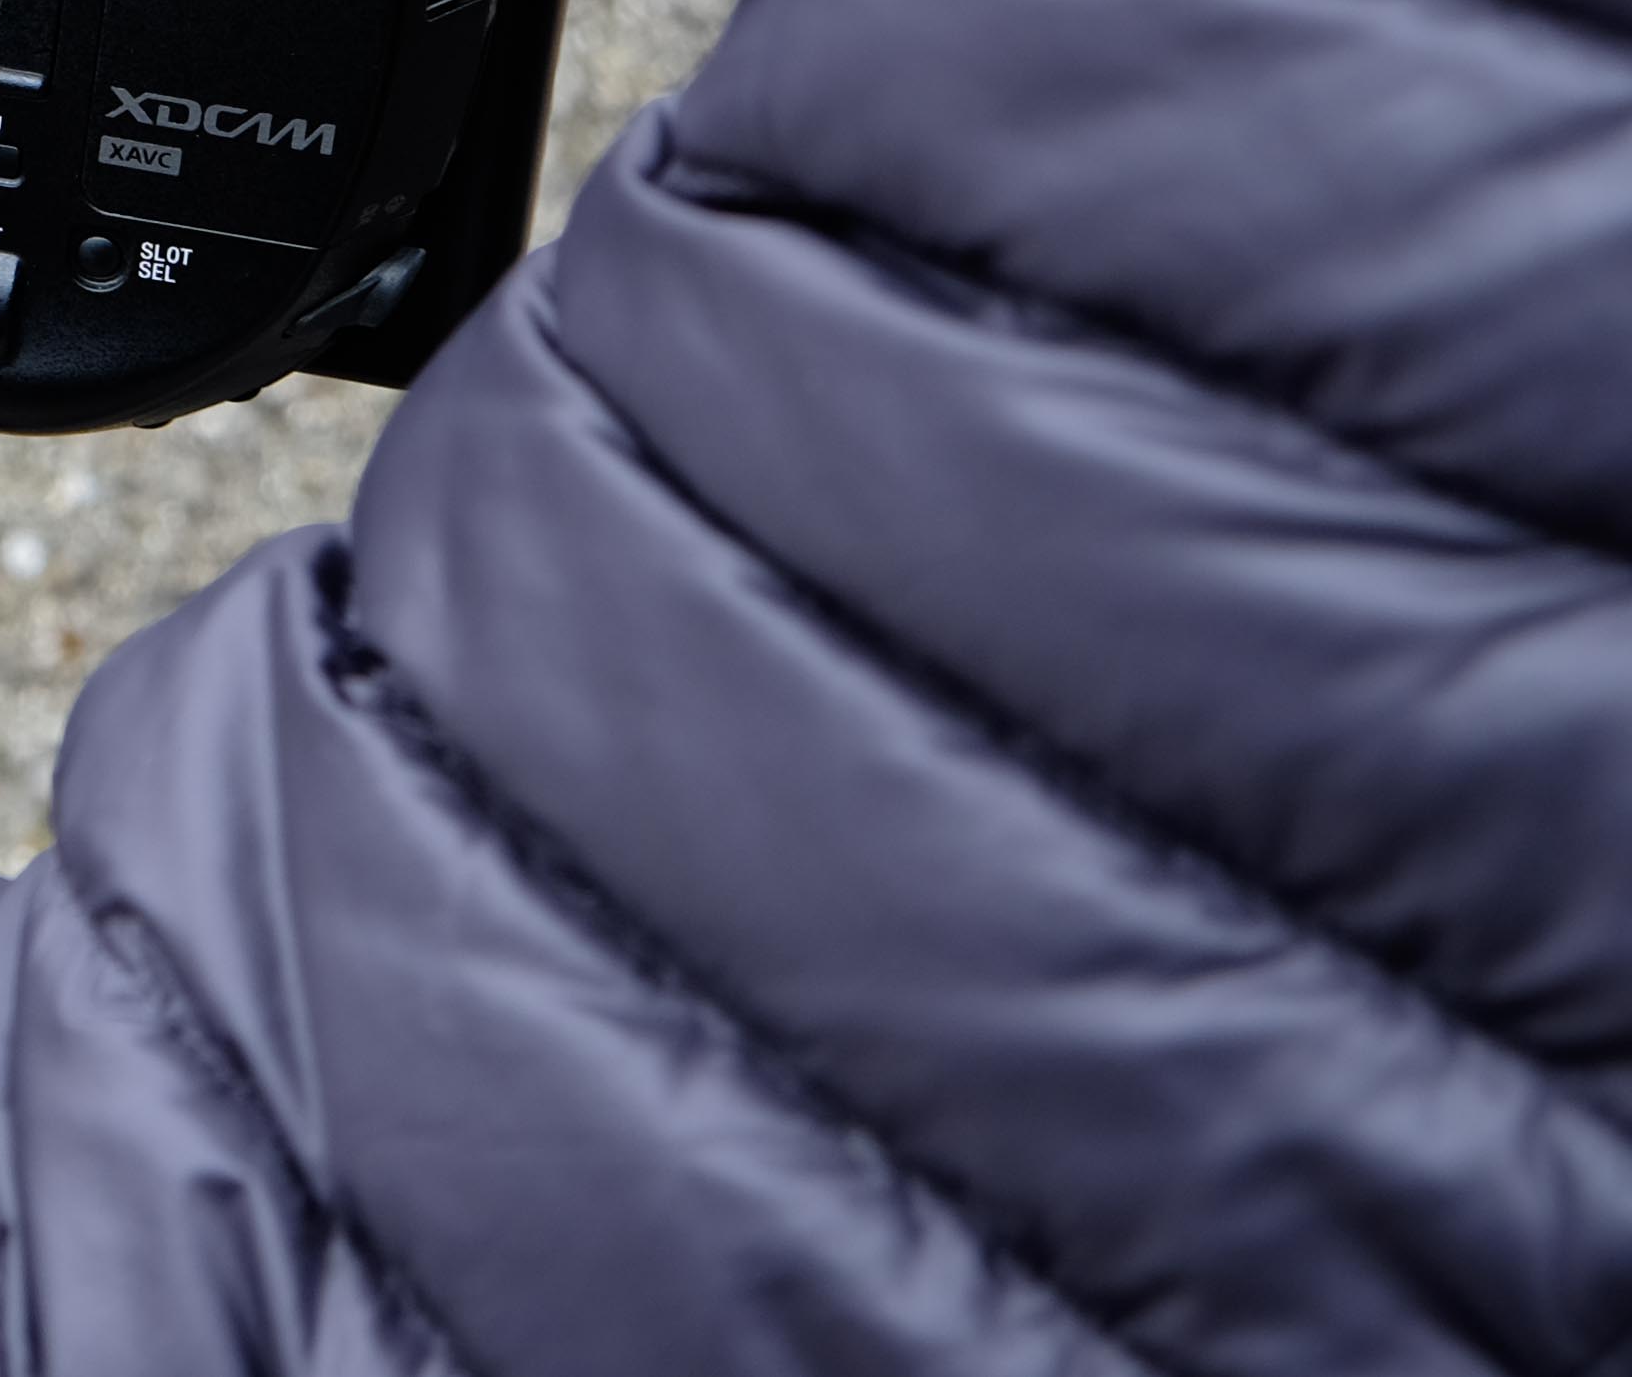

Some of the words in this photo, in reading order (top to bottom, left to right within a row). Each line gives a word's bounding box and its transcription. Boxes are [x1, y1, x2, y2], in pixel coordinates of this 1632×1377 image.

[104, 86, 337, 156] XDCAM
[108, 141, 172, 170] XAVC
[140, 241, 193, 267] SLOT
[138, 262, 177, 284] SEL
